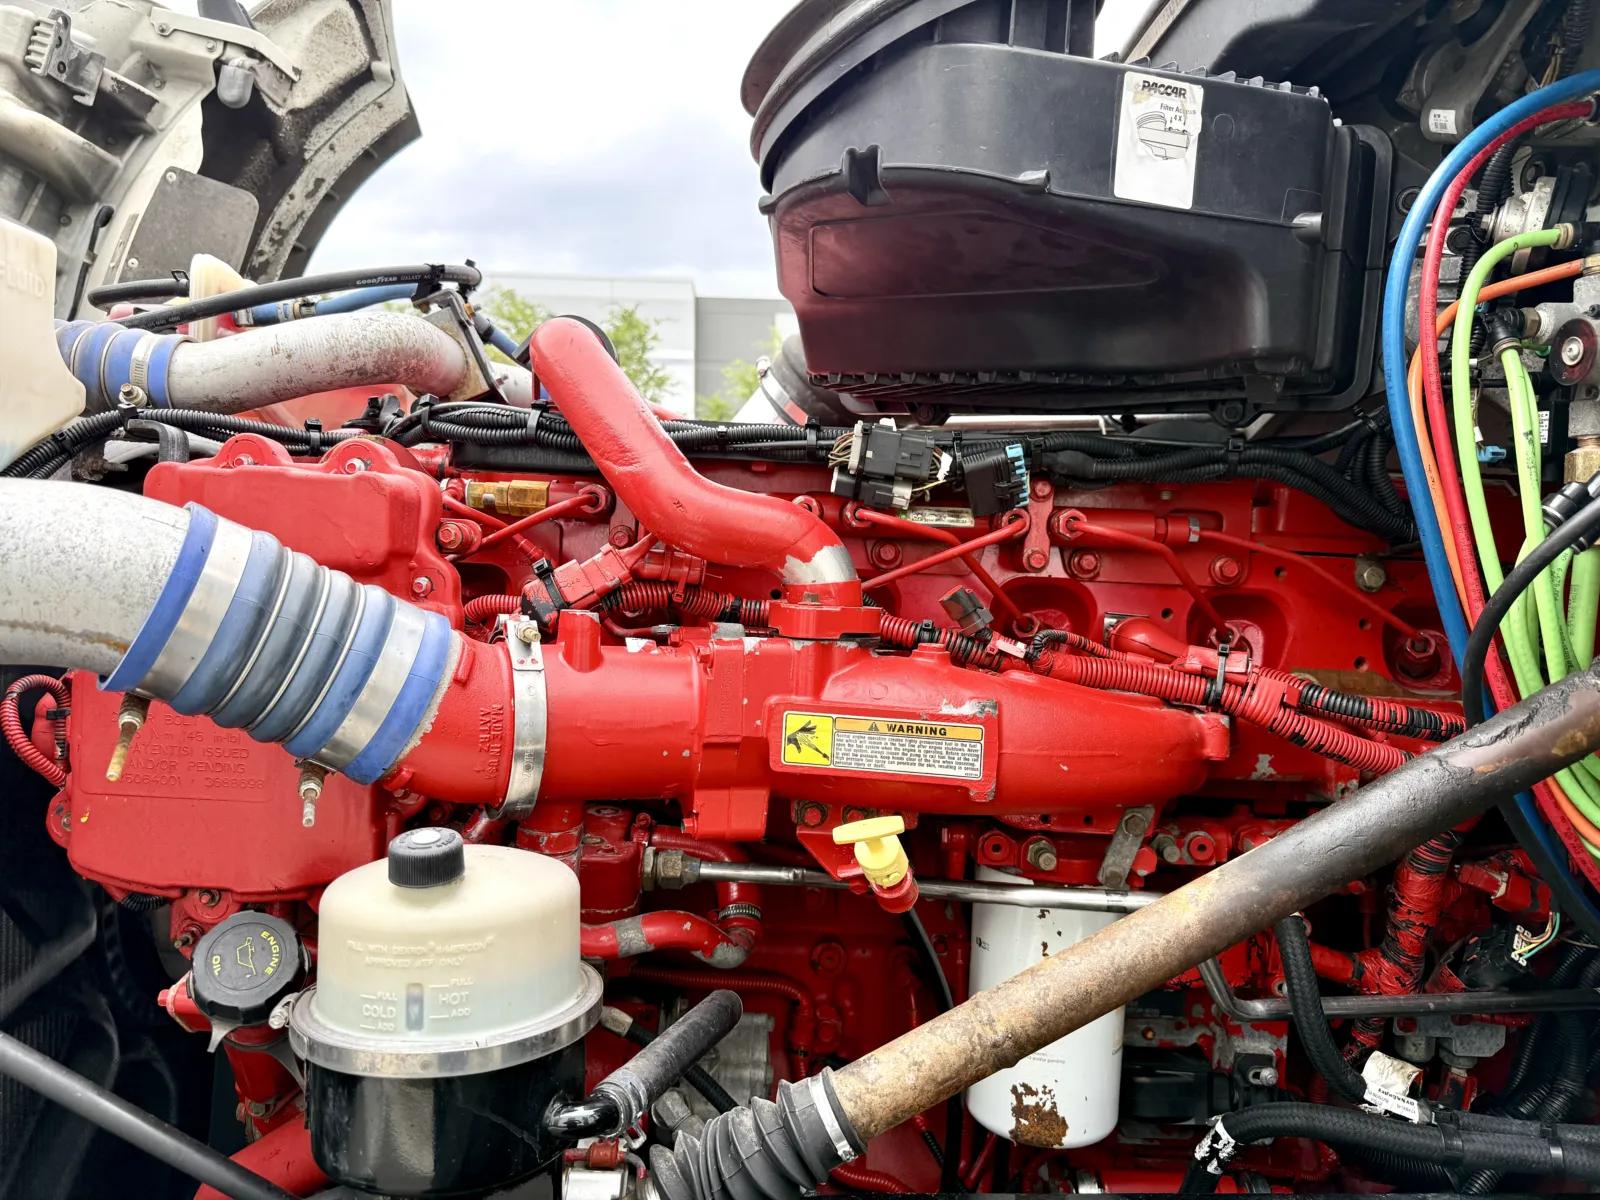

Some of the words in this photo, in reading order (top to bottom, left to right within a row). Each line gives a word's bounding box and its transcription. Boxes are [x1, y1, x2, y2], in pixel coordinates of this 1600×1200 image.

[1141, 80, 1187, 99] PACCAR
[1160, 103, 1174, 113] Filter
[886, 723, 948, 736] WARNING
[189, 762, 246, 774] PENDING
[260, 930, 280, 976] ENGINE
[212, 955, 222, 976] OIL
[439, 955, 466, 968] ONLY
[450, 976, 474, 986] FULL
[377, 991, 398, 1001] FULL
[438, 991, 470, 1006] HOT
[362, 1003, 396, 1018] COLD
[450, 1008, 471, 1018] ADD
[377, 1022, 396, 1032] ADD
